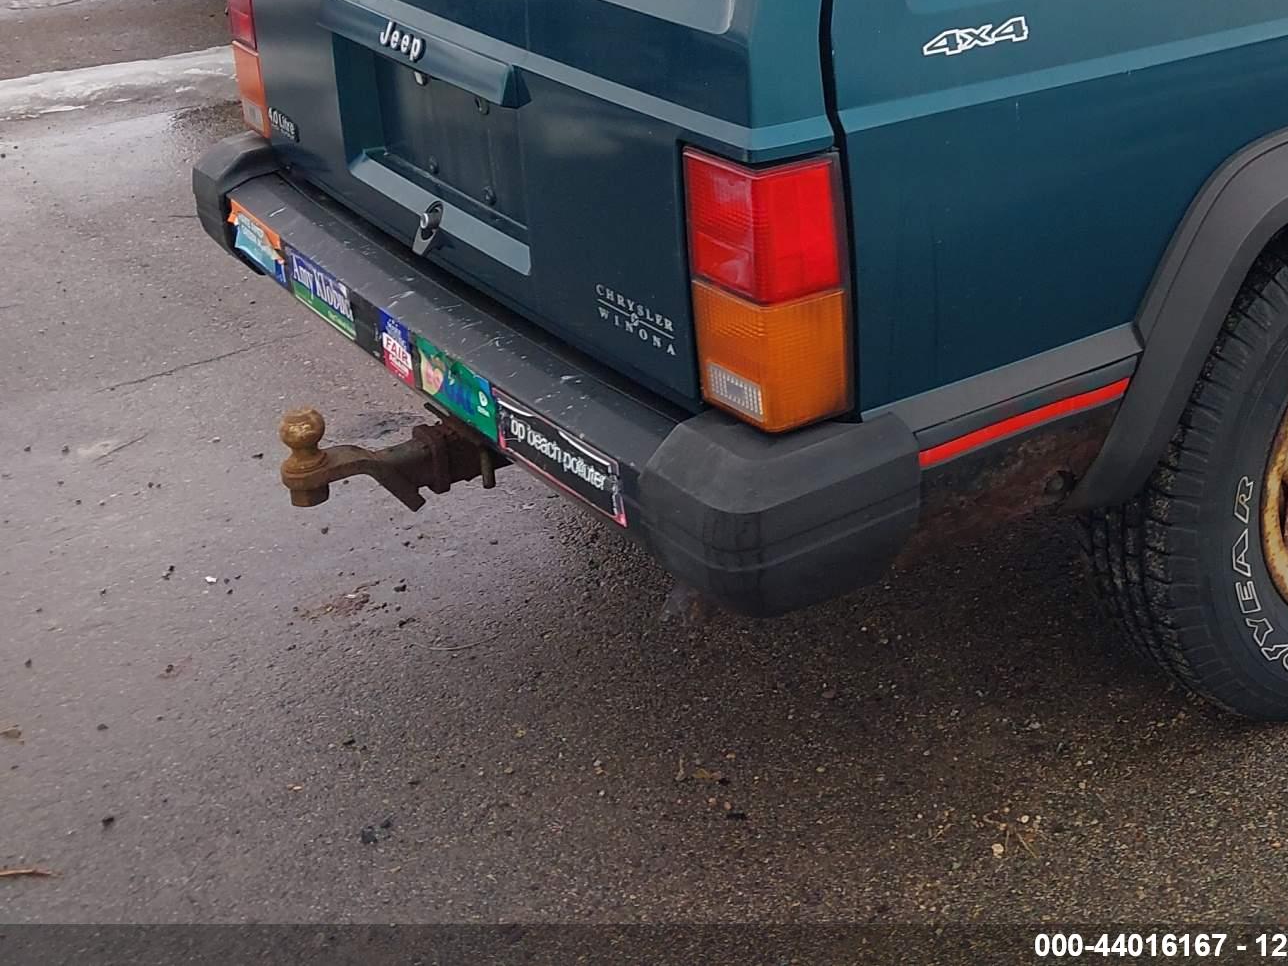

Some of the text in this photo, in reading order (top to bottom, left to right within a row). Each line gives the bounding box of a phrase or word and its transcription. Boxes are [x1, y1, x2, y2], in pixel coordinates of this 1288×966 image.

[380, 21, 421, 61] Jeep
[595, 283, 675, 332] CHRYSLER
[598, 306, 677, 356] WINONA
[563, 451, 607, 491] polluter
